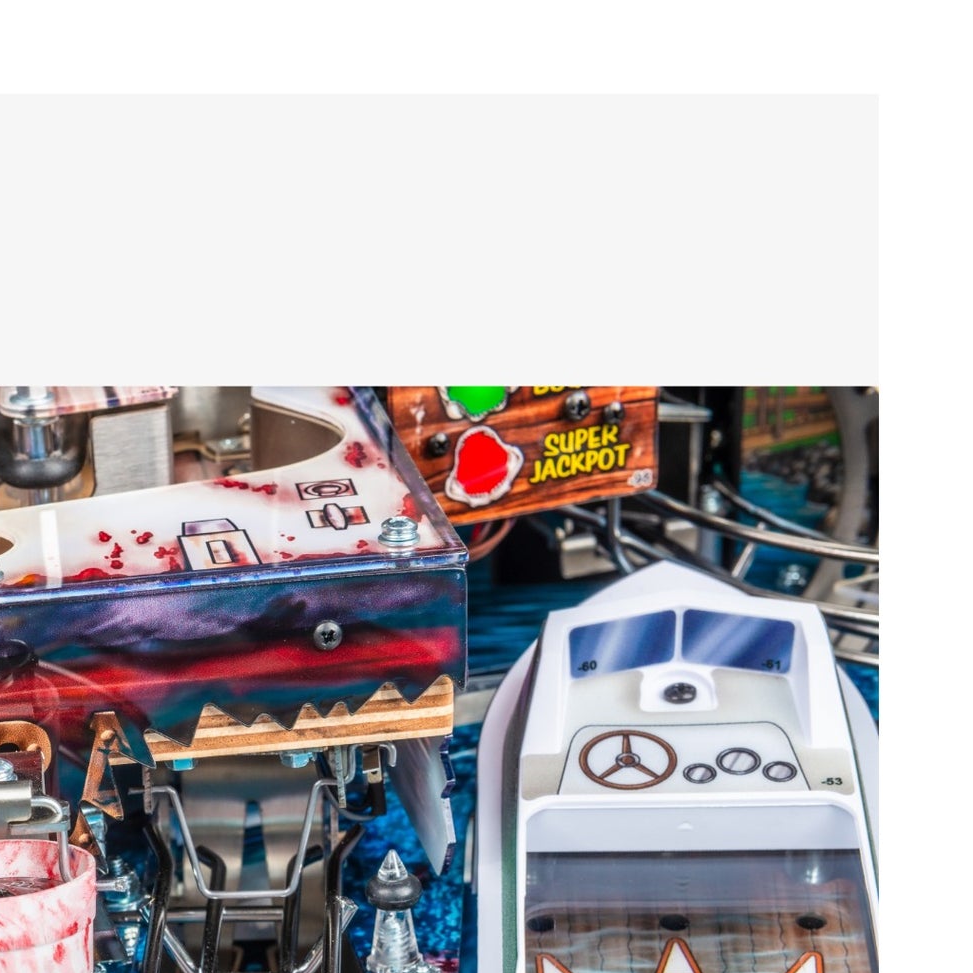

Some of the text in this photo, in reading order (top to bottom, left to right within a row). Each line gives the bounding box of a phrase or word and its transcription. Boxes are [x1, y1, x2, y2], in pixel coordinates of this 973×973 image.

[543, 424, 619, 457] SUPER
[529, 443, 631, 483] JACKPOT
[577, 660, 599, 673] -60
[820, 777, 843, 787] -53
